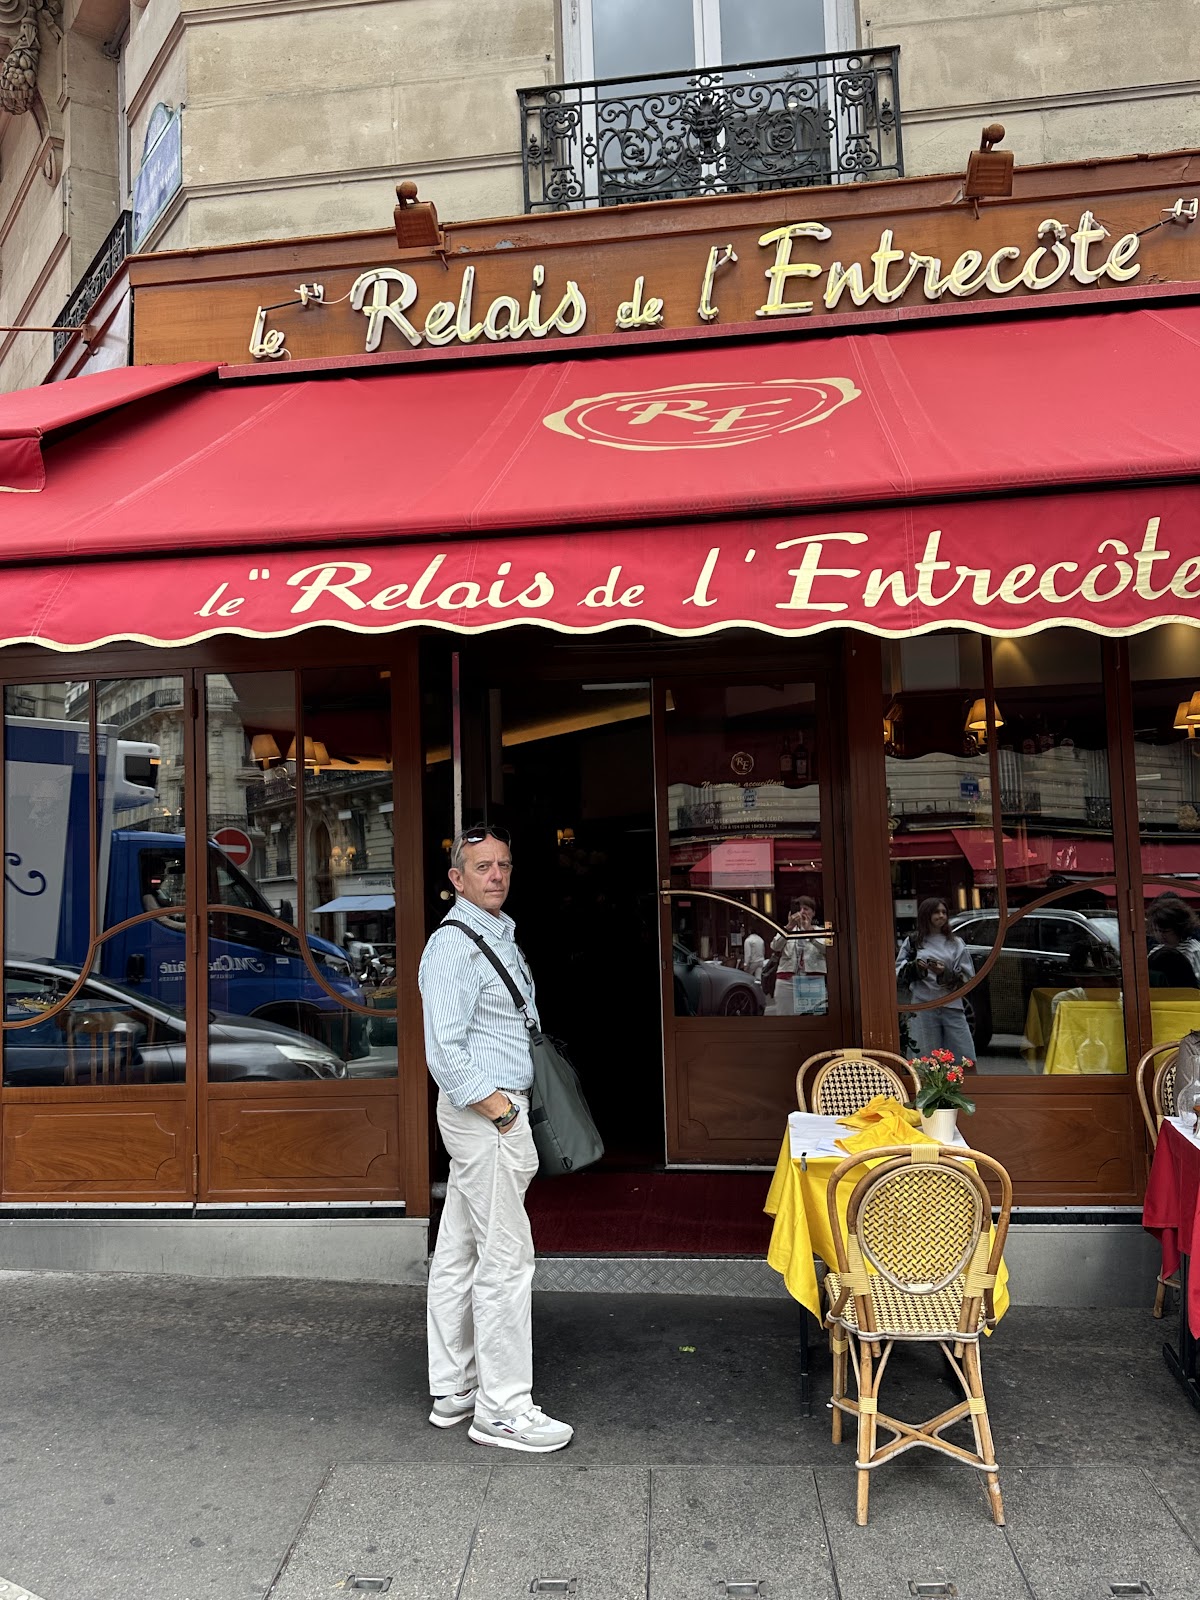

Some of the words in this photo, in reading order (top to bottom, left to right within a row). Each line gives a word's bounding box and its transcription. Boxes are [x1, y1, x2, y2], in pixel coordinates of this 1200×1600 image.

[616, 276, 664, 329] de
[194, 583, 246, 617] le
[577, 566, 645, 608] de
